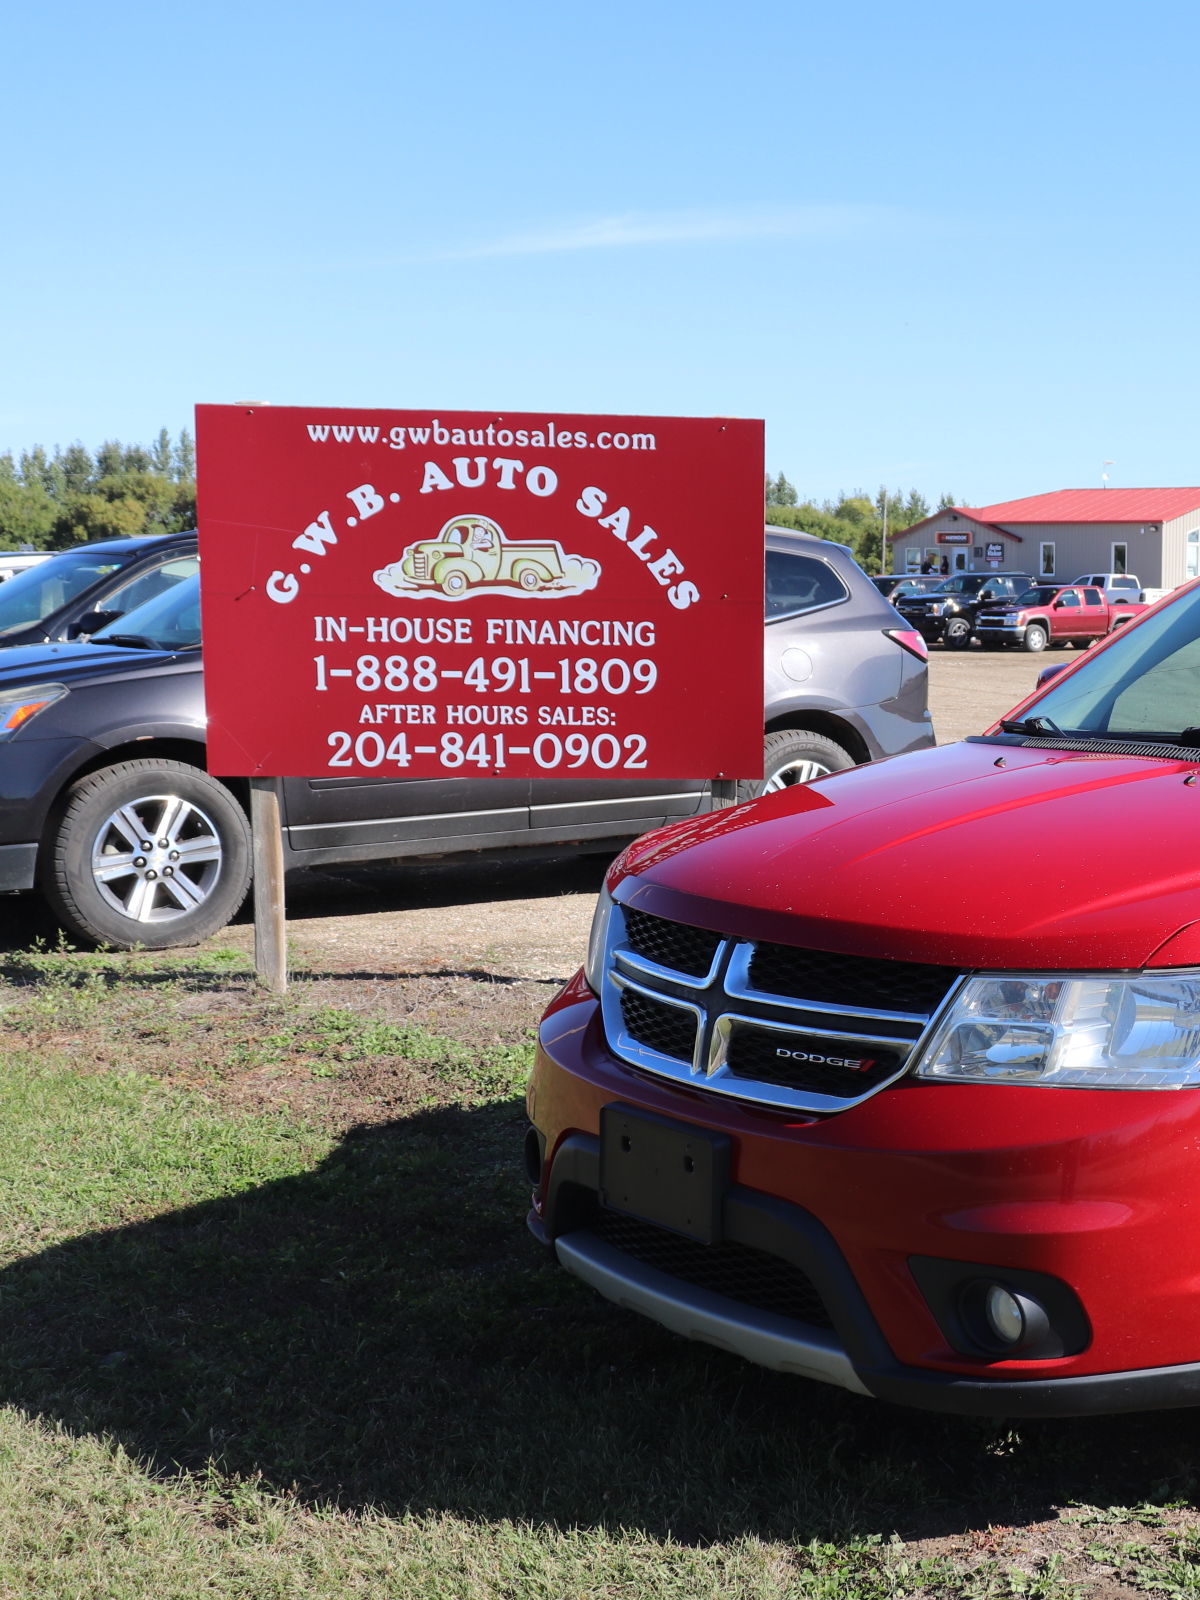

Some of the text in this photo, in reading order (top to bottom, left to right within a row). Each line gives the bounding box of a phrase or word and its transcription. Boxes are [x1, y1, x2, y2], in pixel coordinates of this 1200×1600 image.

[306, 418, 657, 450] www.gwbautosales.com
[265, 456, 700, 610] G.W.B. AUTO SALES
[313, 616, 656, 647] IN-HOUSE FINANCING
[313, 654, 658, 695] 1-888-491-1809
[358, 704, 616, 726] AFTER HOURS SALES:
[327, 730, 648, 770] 204-841-0902
[775, 1048, 862, 1069] DODGE
